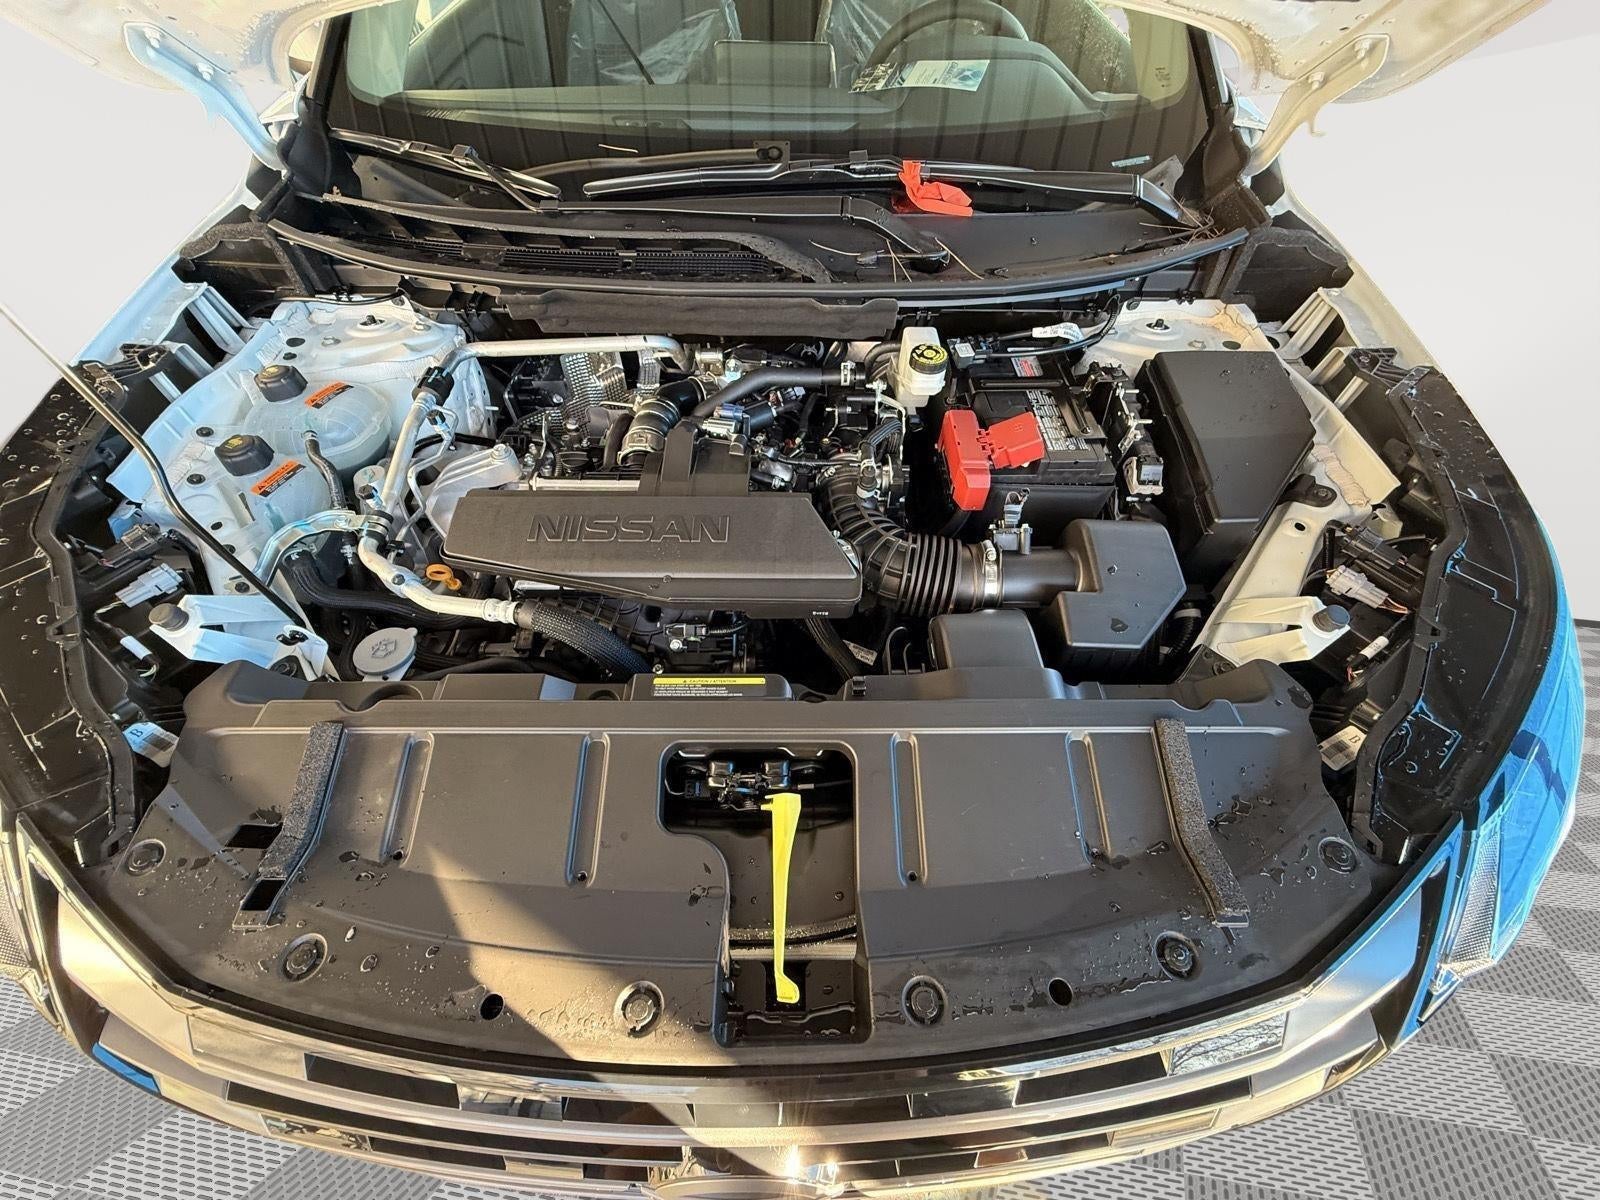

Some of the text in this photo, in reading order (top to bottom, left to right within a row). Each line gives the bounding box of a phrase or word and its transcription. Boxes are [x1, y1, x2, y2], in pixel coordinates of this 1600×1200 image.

[527, 514, 729, 541] NISSAN
[130, 728, 143, 738] B
[1348, 735, 1361, 744] B
